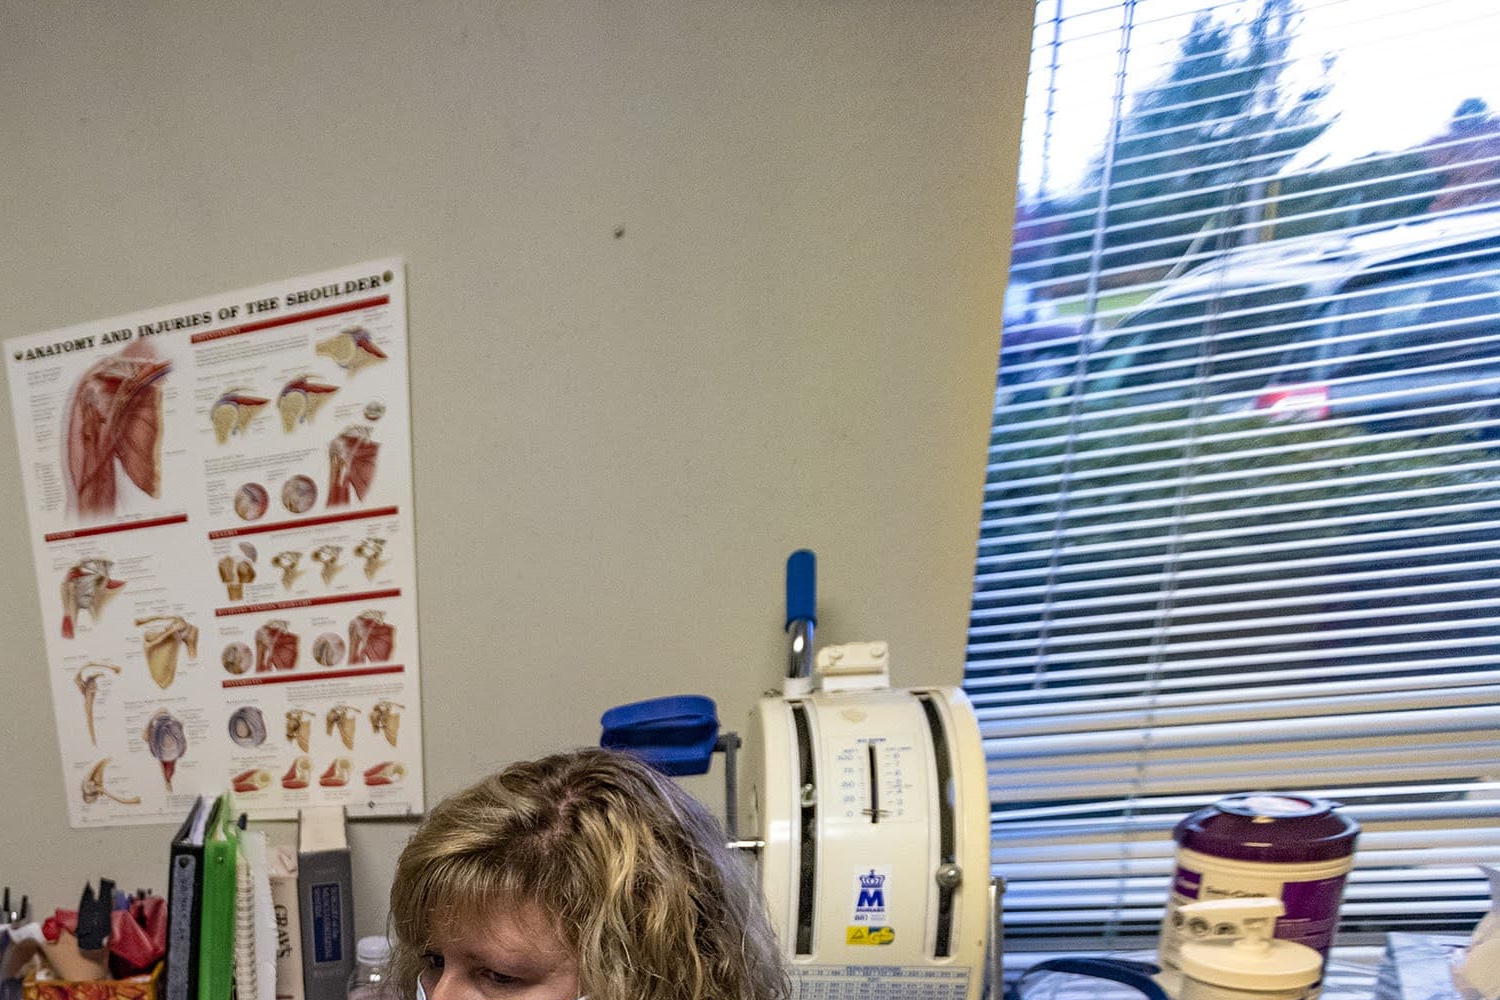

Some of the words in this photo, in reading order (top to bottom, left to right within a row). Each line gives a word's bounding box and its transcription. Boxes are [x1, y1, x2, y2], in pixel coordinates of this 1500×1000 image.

[26, 335, 96, 360] ANATOMY
[100, 328, 133, 345] AND
[138, 311, 212, 337] INJURIES
[218, 305, 241, 321] OF
[245, 296, 280, 314] THE
[286, 275, 382, 306] SHOULDER
